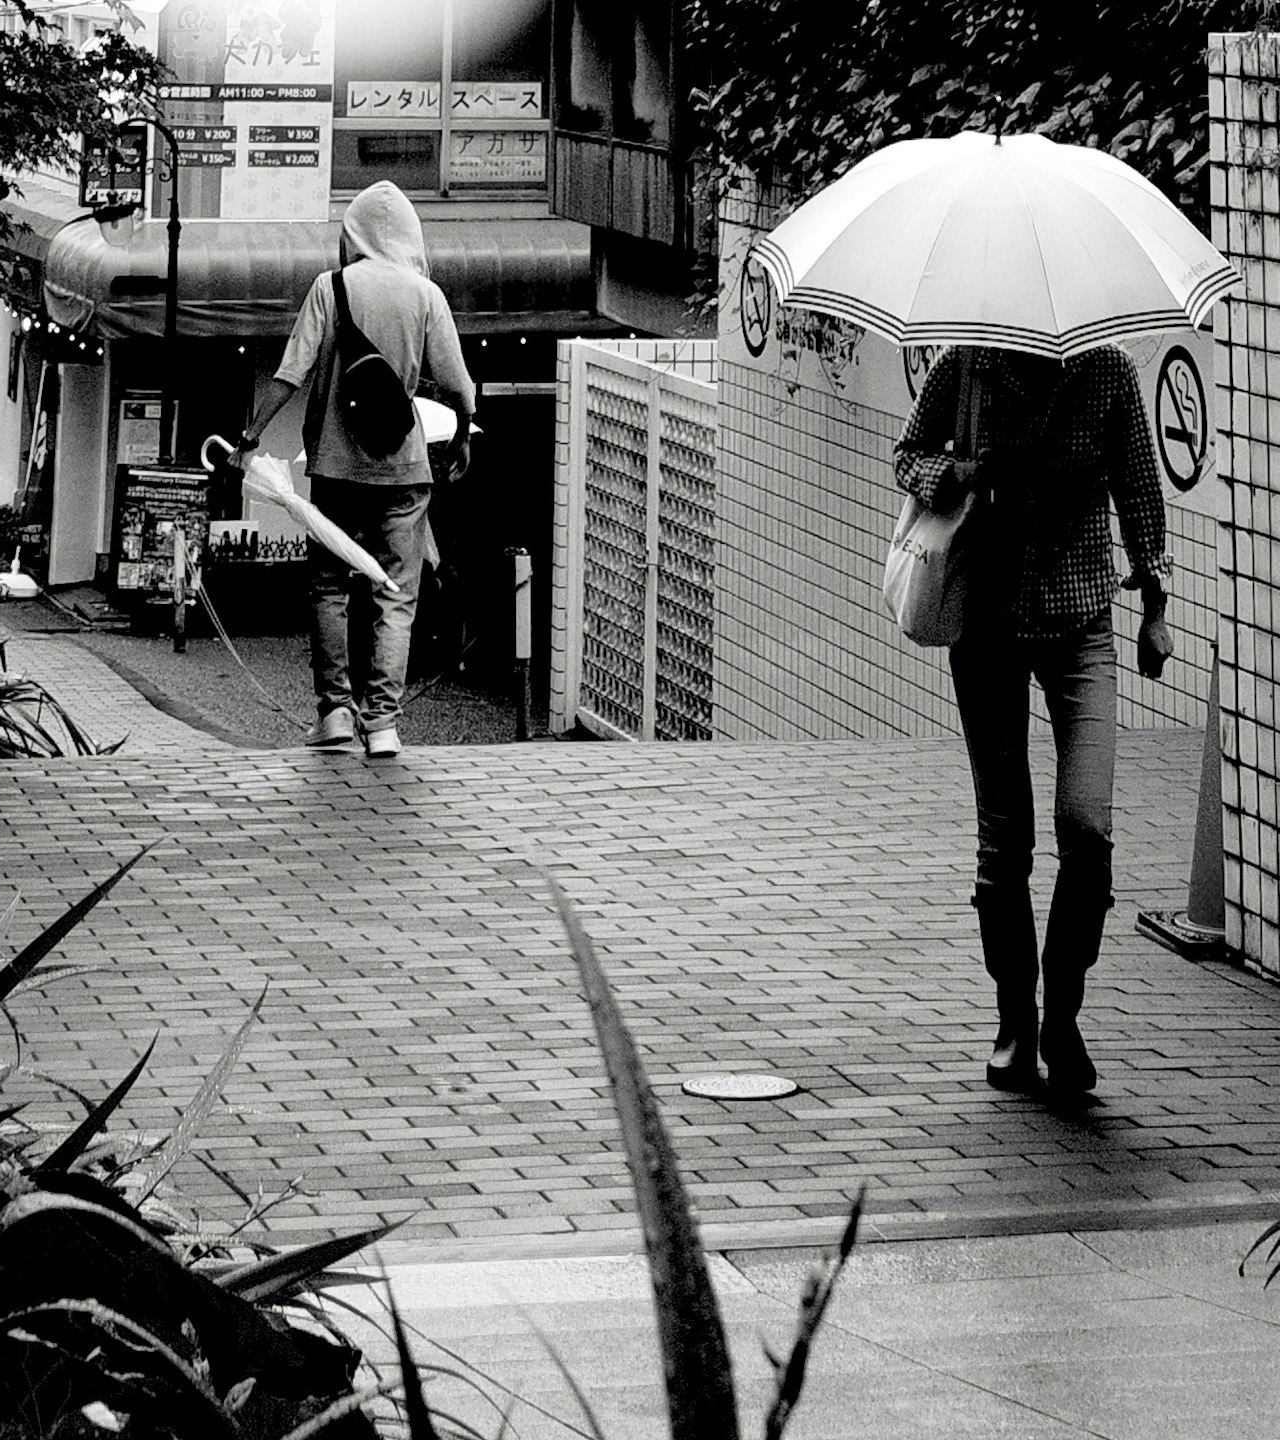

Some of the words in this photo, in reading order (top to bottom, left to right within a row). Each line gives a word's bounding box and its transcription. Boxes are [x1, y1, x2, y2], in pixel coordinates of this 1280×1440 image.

[223, 34, 321, 67] 犬カフェ
[171, 86, 211, 98] 営業時間
[350, 88, 438, 109] レンタル
[451, 90, 539, 109] スペース
[204, 129, 231, 140] ¥200
[287, 129, 314, 140] ¥350
[456, 133, 540, 154] アガサ
